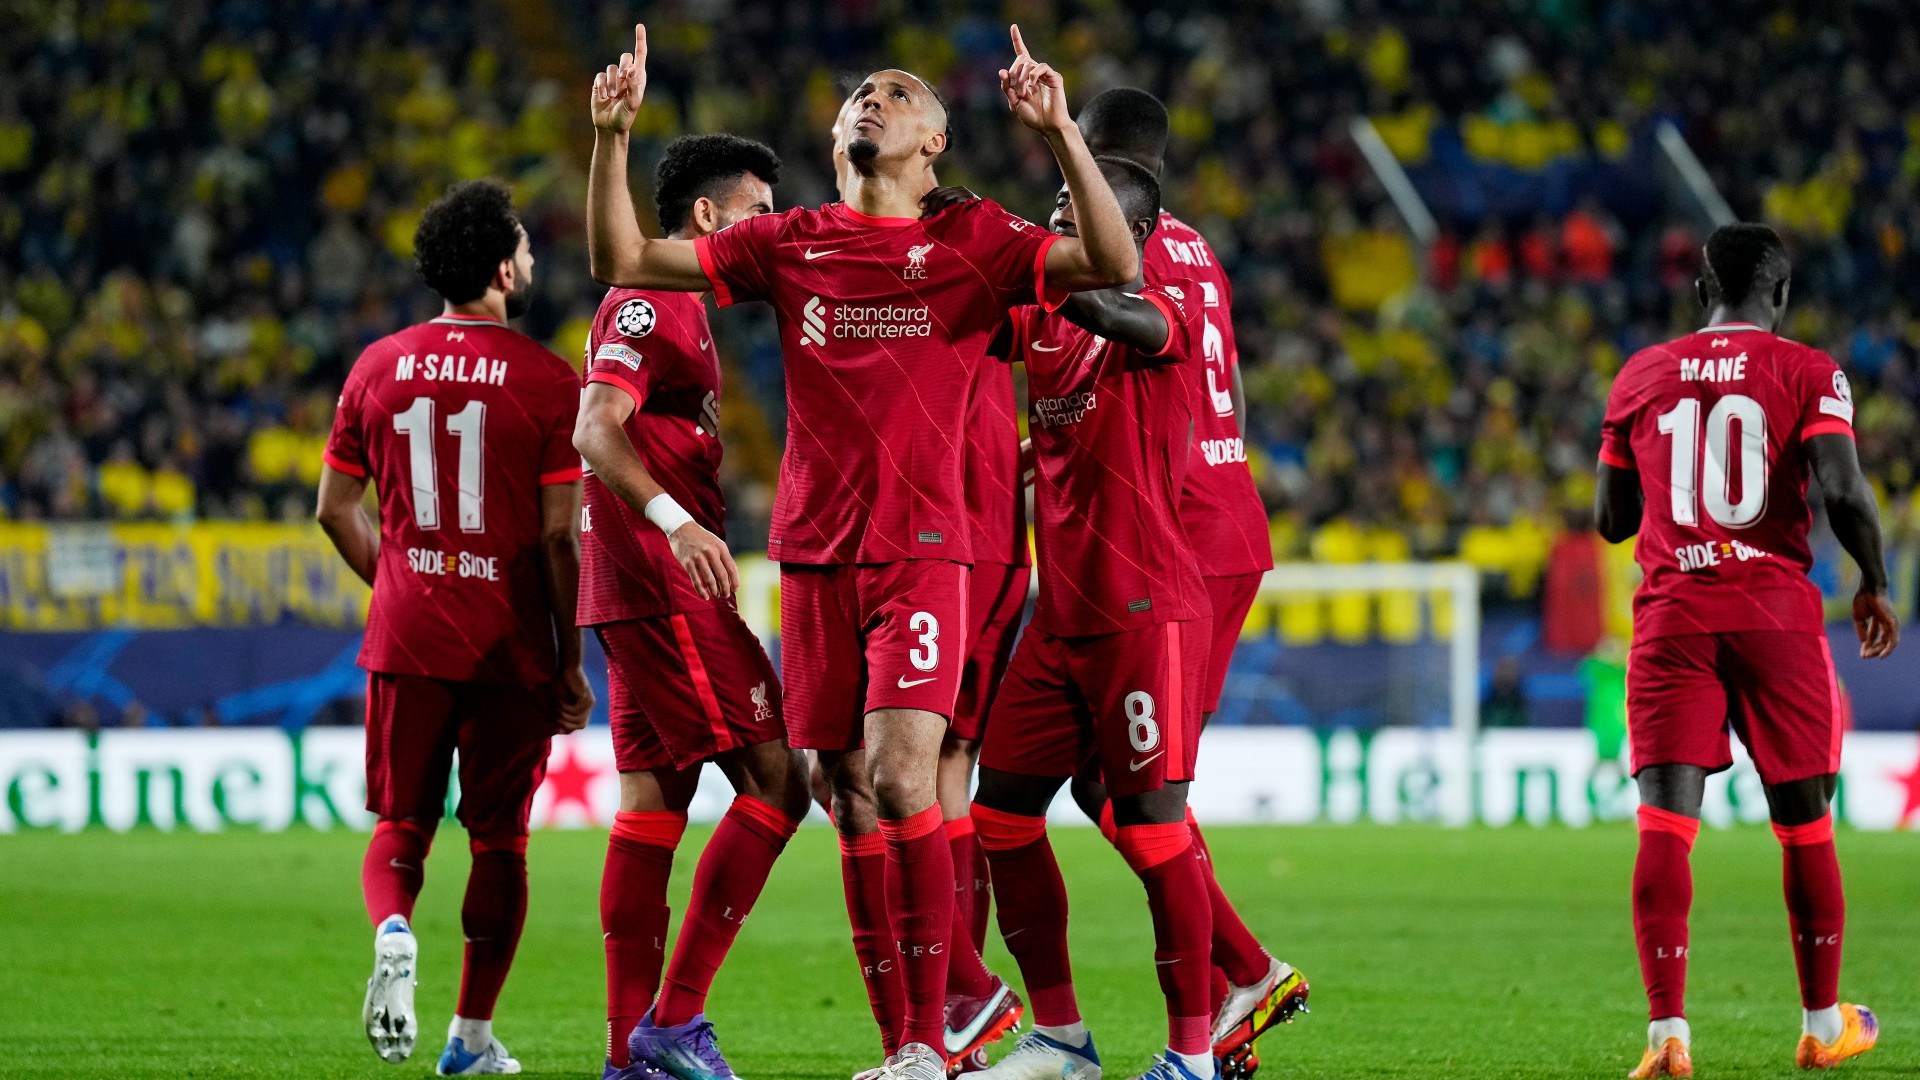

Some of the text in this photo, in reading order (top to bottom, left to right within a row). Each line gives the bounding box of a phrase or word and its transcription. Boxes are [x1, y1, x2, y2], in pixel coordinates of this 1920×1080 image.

[833, 304, 928, 321] standard
[833, 321, 931, 338] chartered
[1680, 351, 1748, 382] MANÉ
[393, 397, 486, 534] 11
[1658, 394, 1768, 529] 10
[407, 547, 446, 576] SIDE
[459, 550, 500, 582] SIDE
[1675, 541, 1721, 573] SIDE
[909, 611, 940, 672] 3
[1124, 690, 1160, 753] 8
